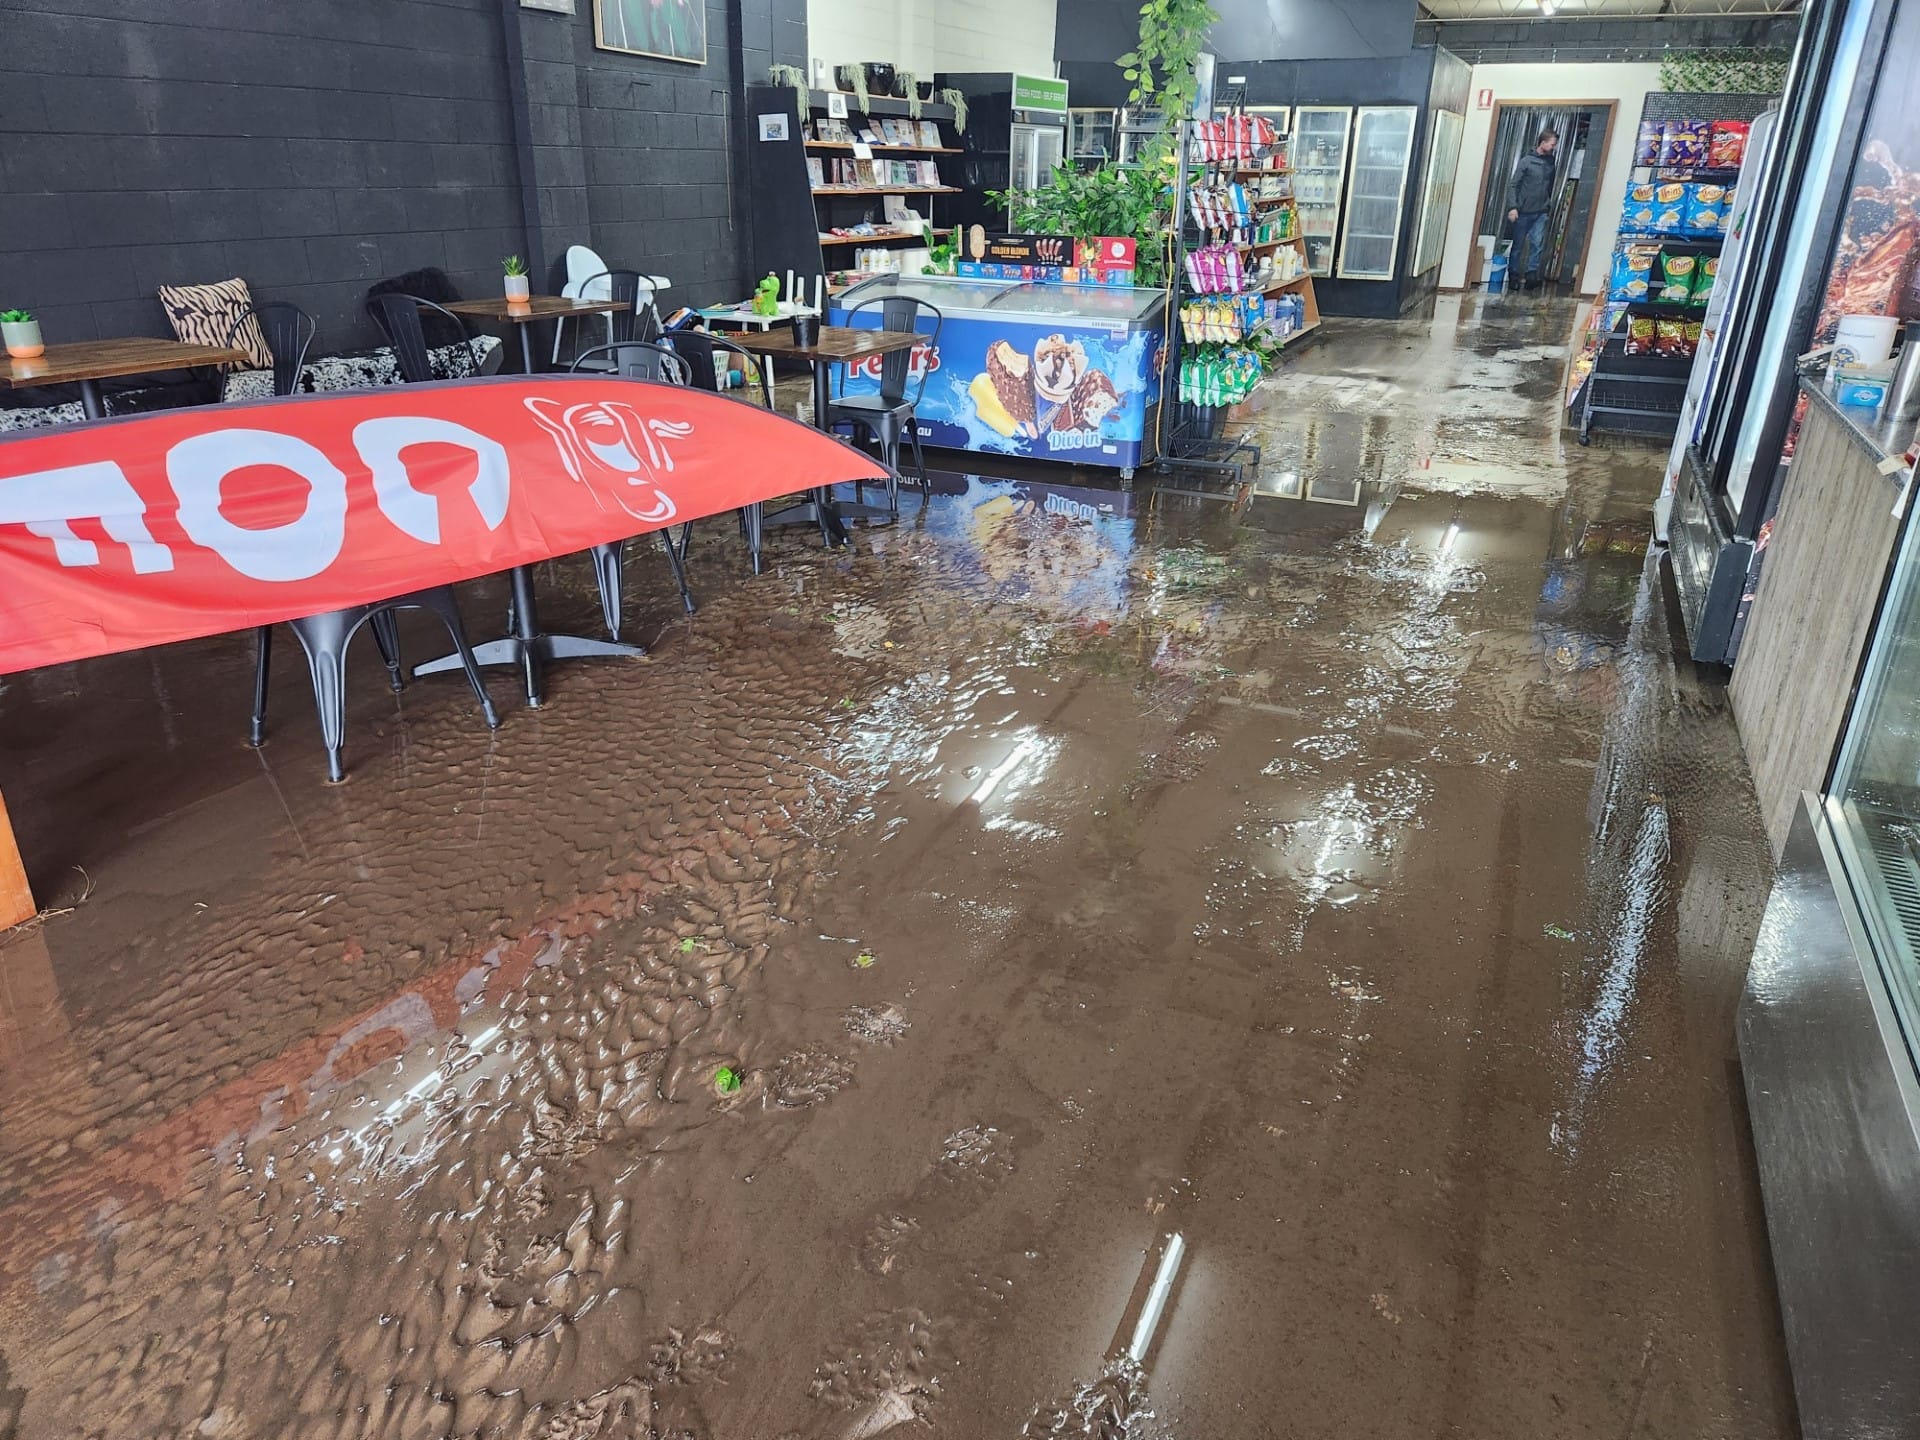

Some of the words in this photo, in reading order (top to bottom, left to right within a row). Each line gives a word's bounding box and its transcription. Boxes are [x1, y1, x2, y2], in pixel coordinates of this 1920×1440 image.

[1671, 260, 1693, 272] Thins
[848, 346, 940, 378] Pers
[1047, 430, 1083, 450] Dive
[1083, 428, 1102, 448] in
